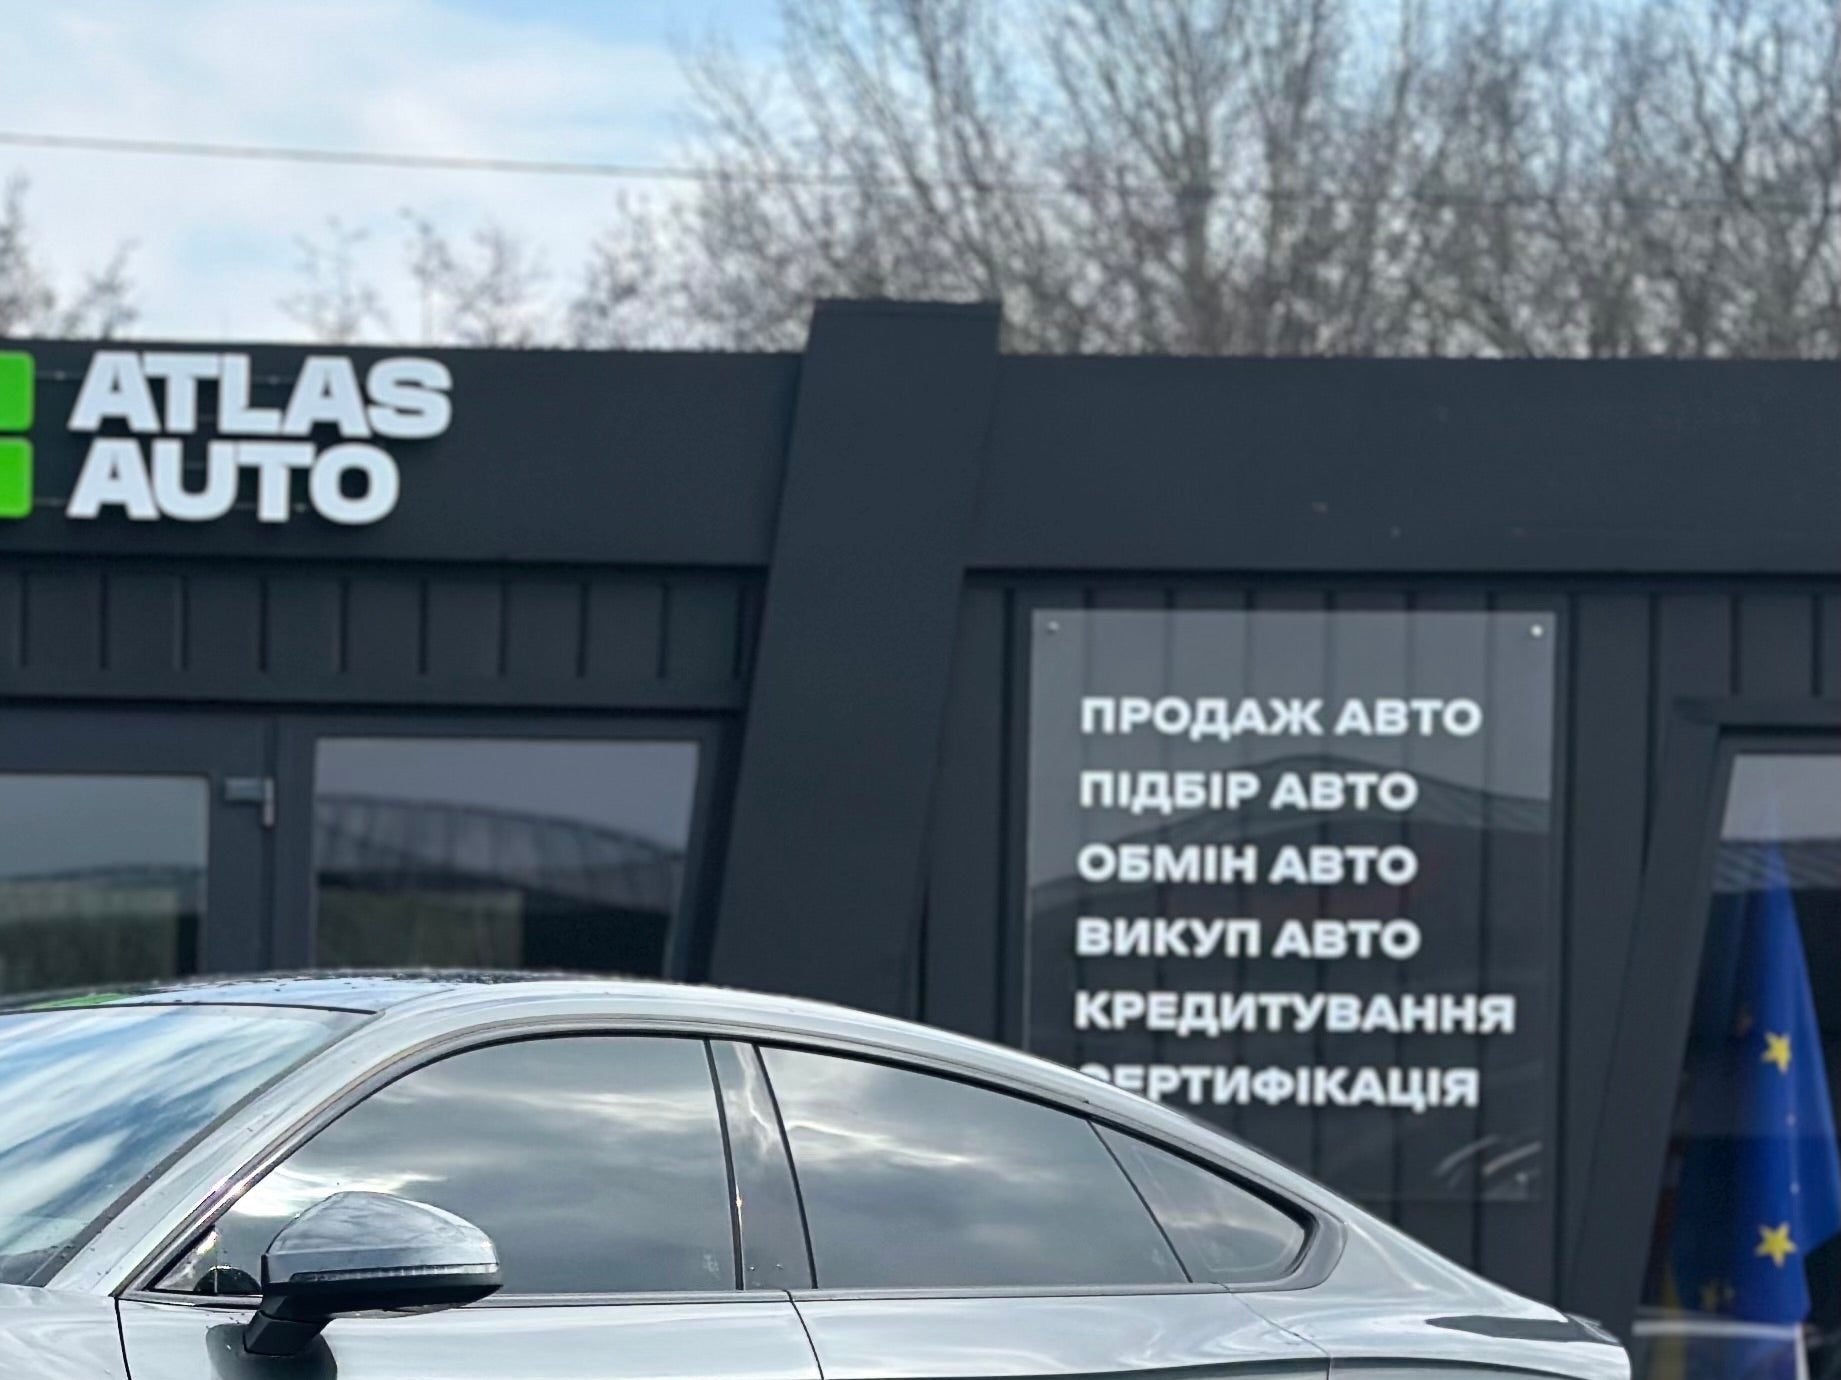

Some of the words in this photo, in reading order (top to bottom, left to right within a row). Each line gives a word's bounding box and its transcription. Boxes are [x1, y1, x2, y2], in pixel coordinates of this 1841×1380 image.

[67, 350, 453, 439] ATLAS
[66, 438, 400, 525] AUTO
[1080, 696, 1322, 742] ПРОДАЖ
[1333, 697, 1483, 736] АВТО
[1079, 770, 1260, 815] ПІДБІР
[1269, 772, 1419, 812] АВТО
[1076, 843, 1258, 884] ОБМІН
[1268, 845, 1419, 885] АВТО
[1075, 917, 1262, 957] ВИКУП
[1271, 919, 1422, 959] АВТО
[1074, 991, 1517, 1037] КРЕДИТУВАННЯ
